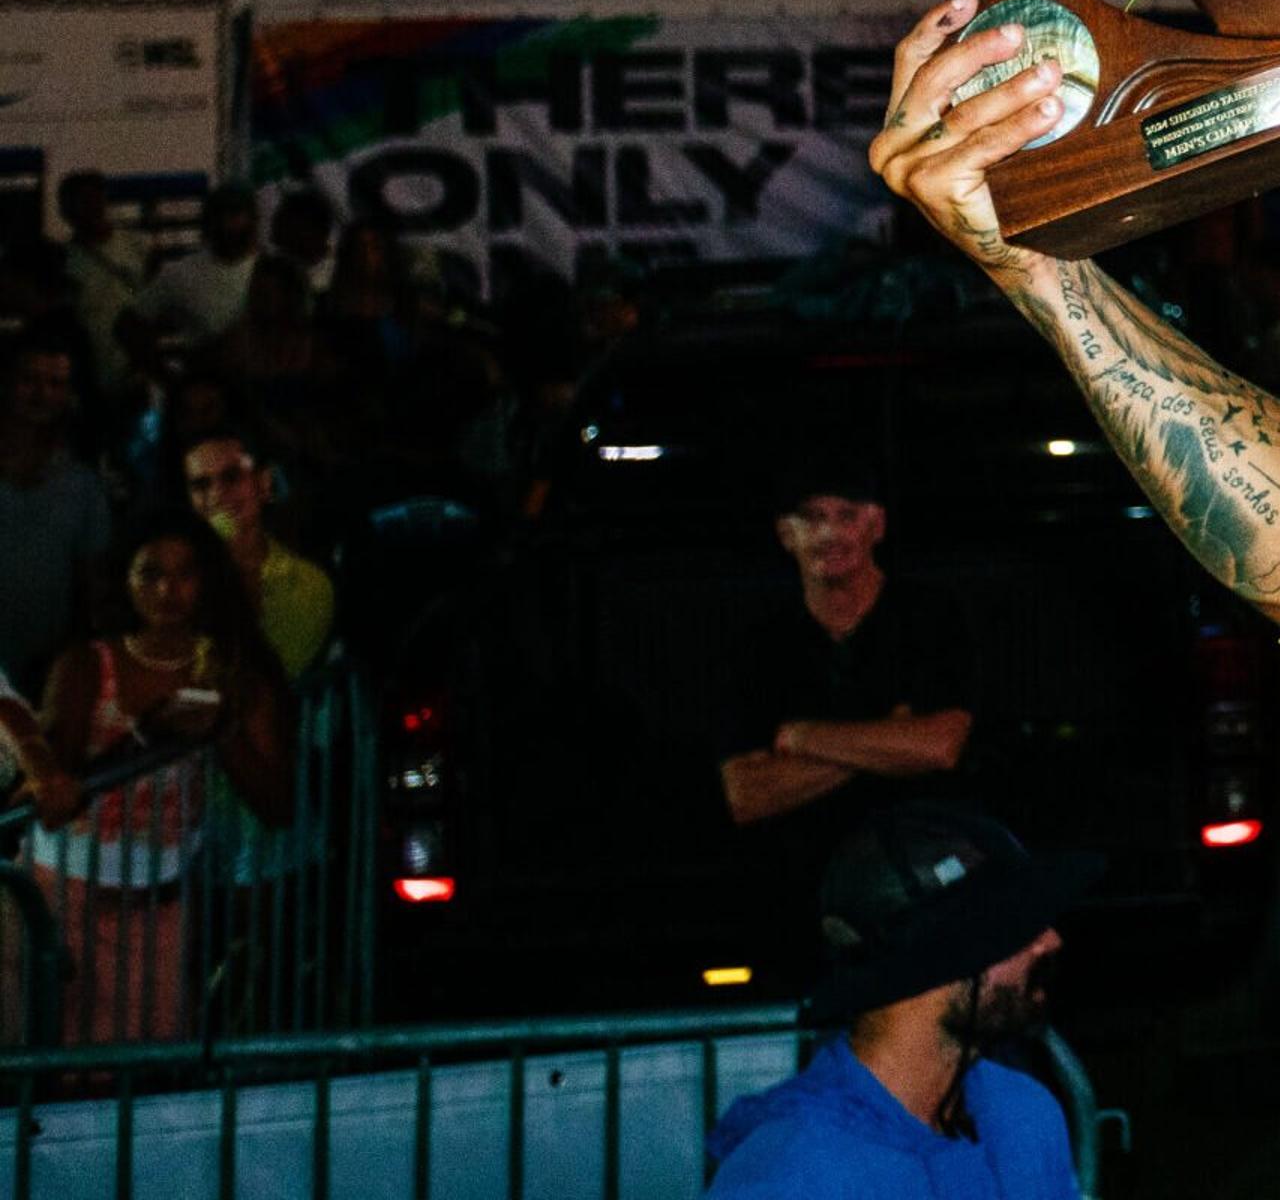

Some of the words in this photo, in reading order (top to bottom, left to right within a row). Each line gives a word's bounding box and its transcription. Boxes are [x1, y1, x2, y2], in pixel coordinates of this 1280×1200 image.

[1145, 119, 1169, 136] 2024
[1164, 134, 1206, 160] MEN'S
[347, 142, 803, 233] ONLY
